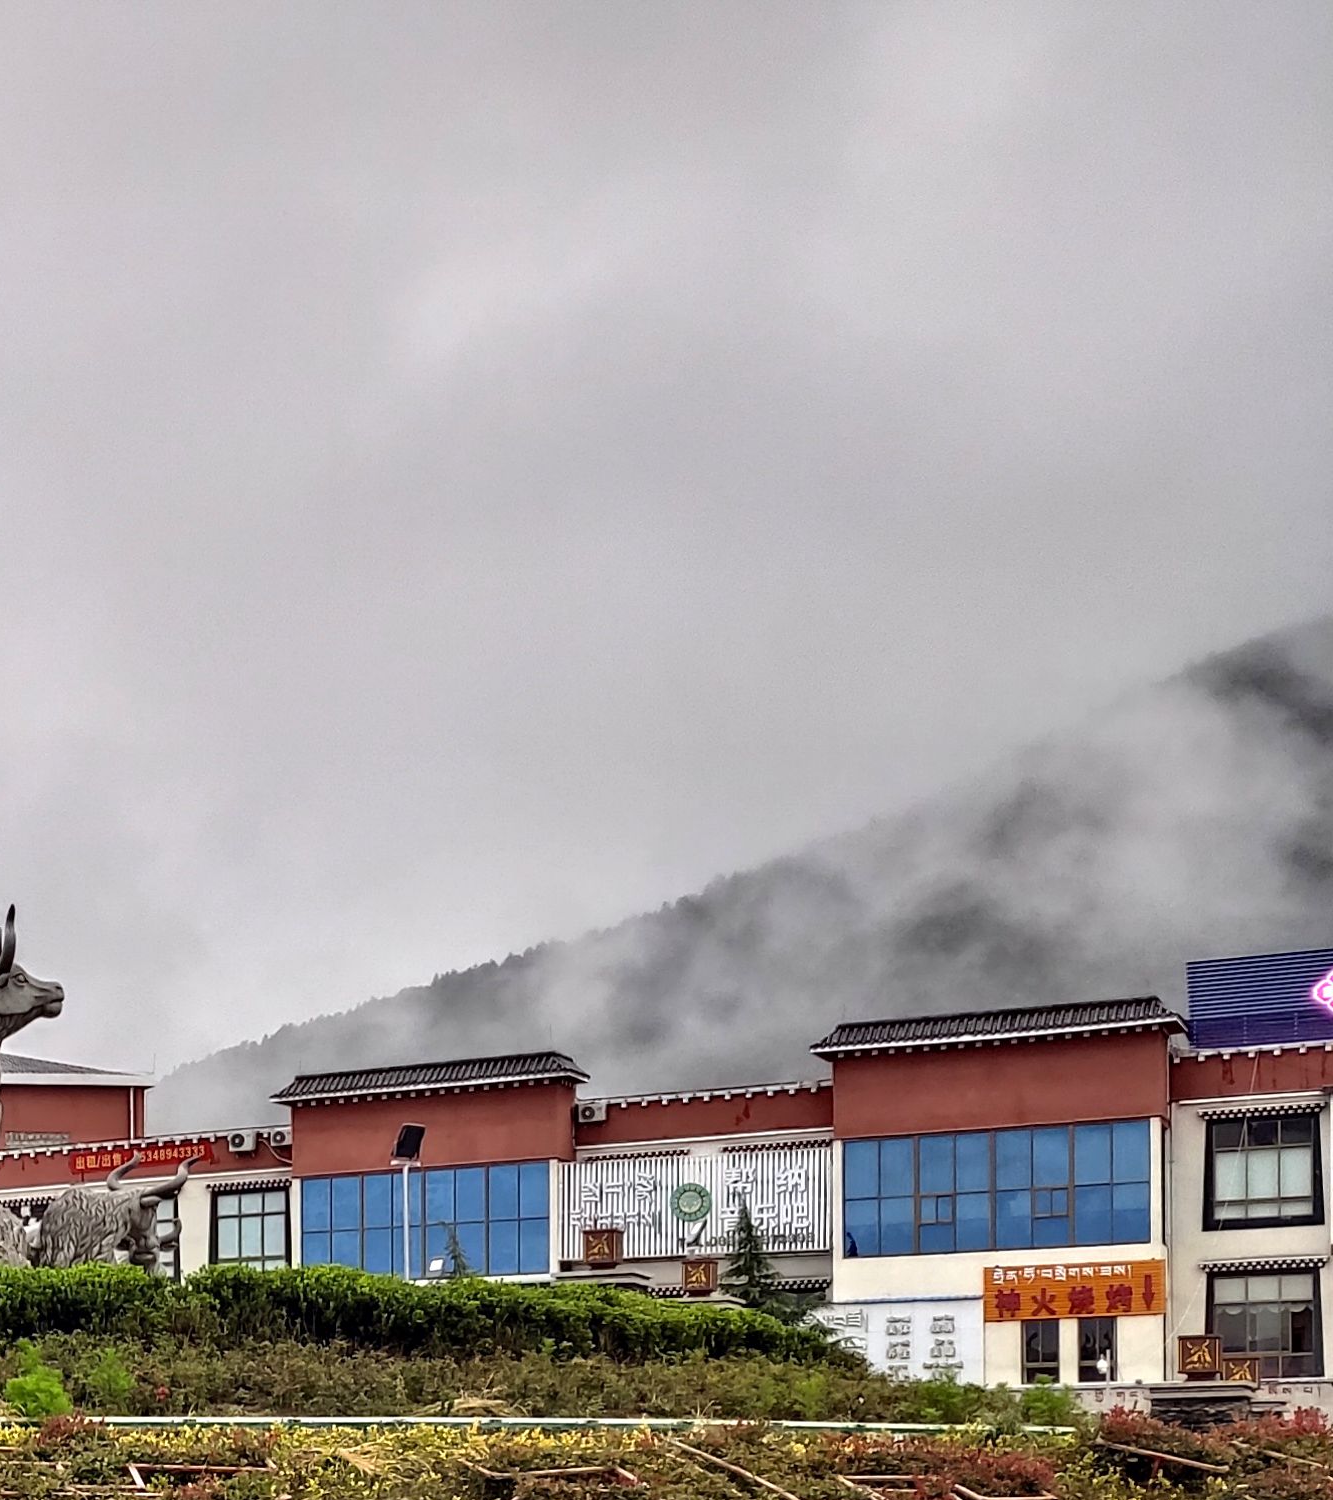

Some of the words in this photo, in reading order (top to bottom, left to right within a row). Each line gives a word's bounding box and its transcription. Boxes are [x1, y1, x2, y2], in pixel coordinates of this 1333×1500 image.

[720, 1203, 812, 1233] 音乐吧
[995, 1283, 1133, 1318] 神火烧烤
